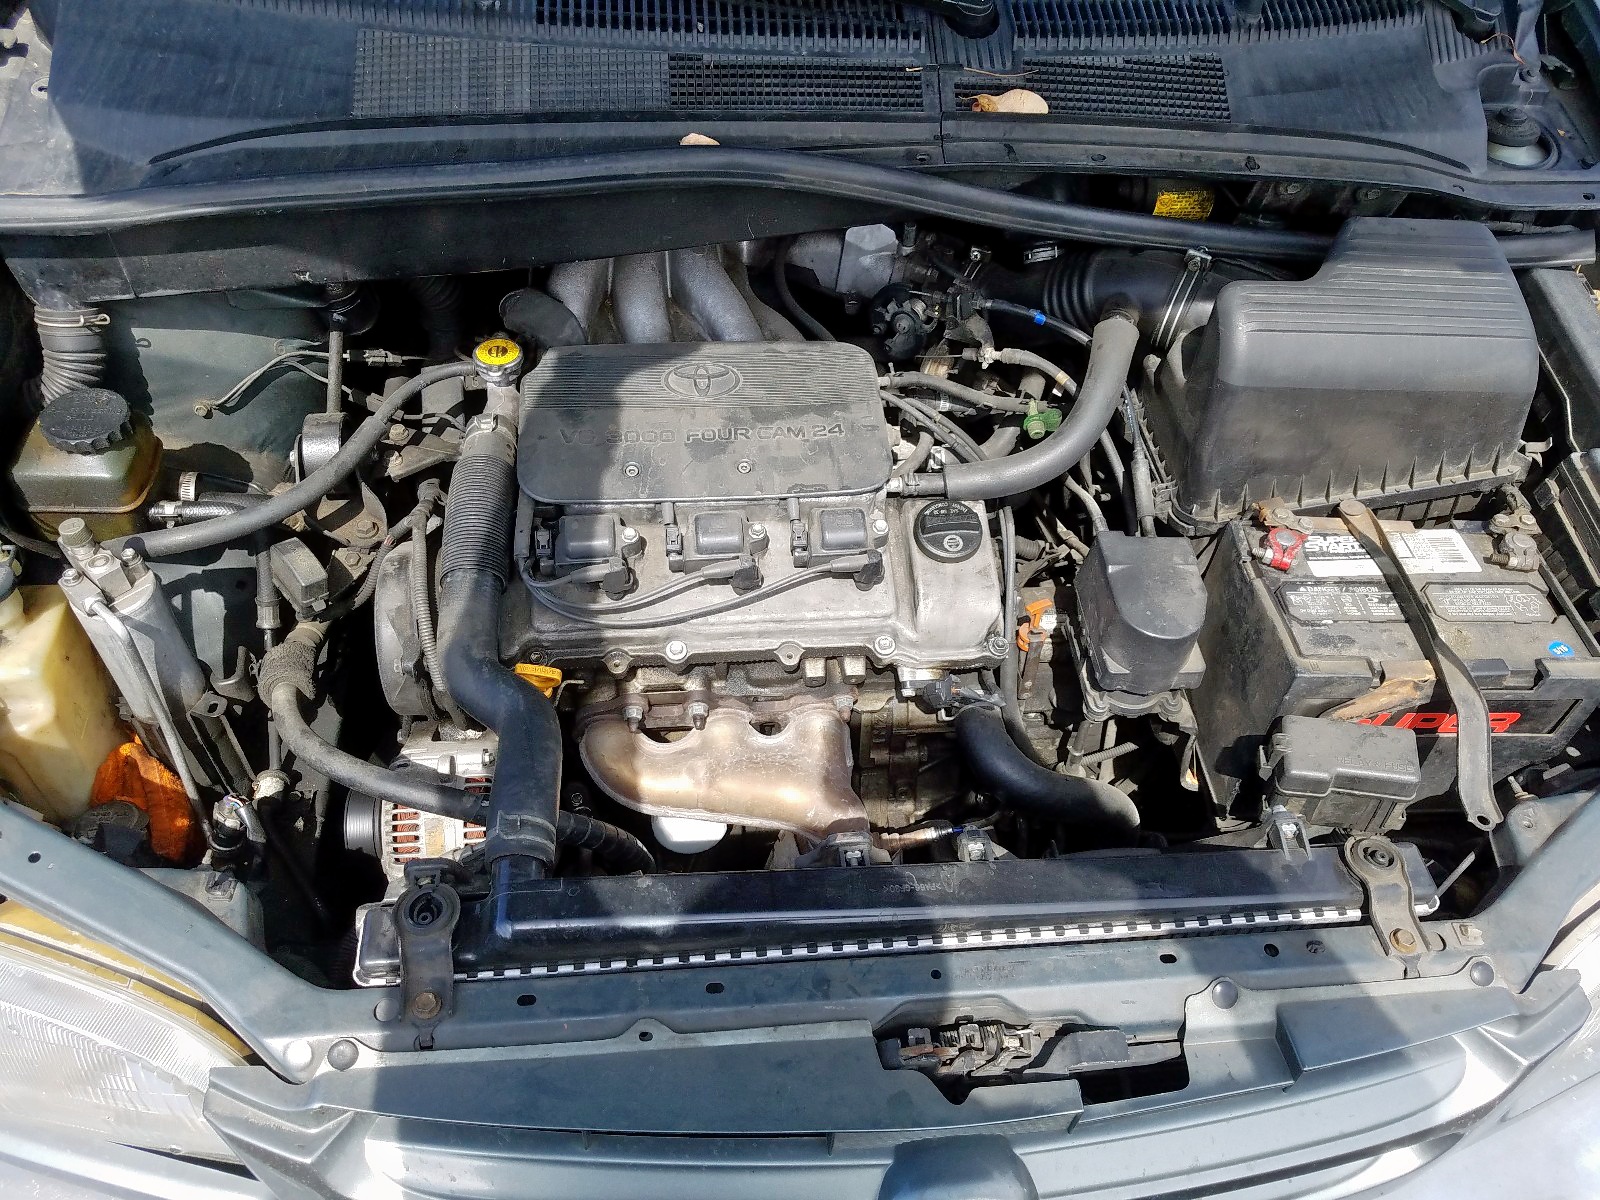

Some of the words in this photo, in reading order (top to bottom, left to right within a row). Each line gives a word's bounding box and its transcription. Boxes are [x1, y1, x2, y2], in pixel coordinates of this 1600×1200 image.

[560, 429, 596, 445] V6
[605, 429, 676, 445] 3000
[686, 427, 753, 443] FOUR
[757, 424, 806, 441] CAM
[811, 423, 844, 438] 24
[1336, 756, 1372, 767] RELAY
[1374, 760, 1381, 768] &
[1384, 761, 1415, 773] FUSE
